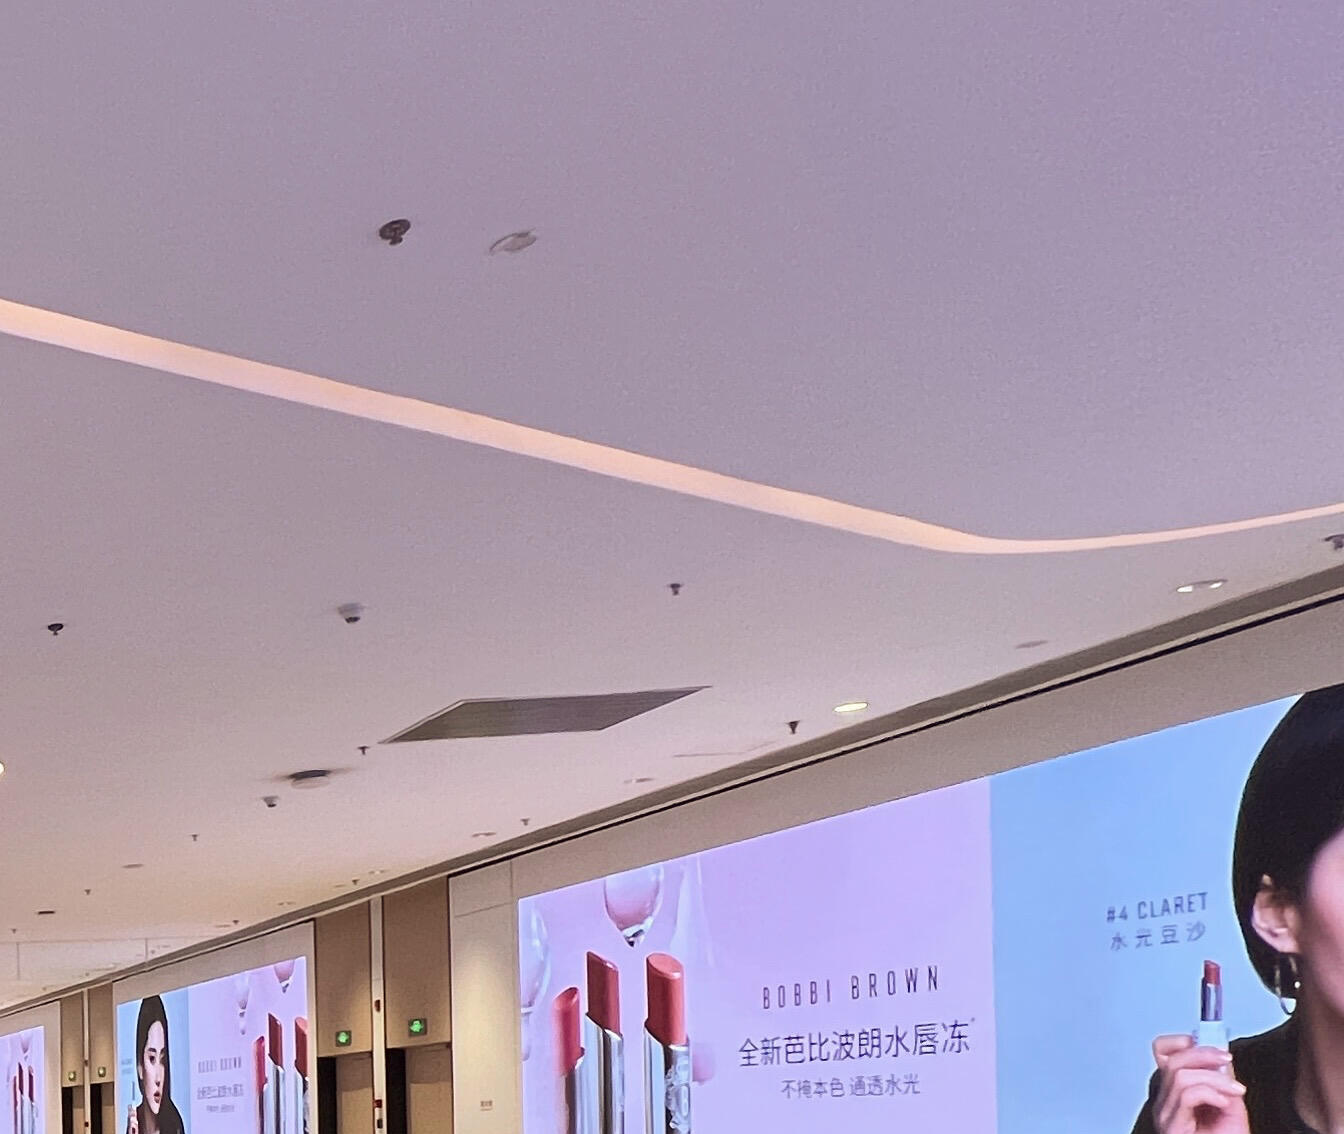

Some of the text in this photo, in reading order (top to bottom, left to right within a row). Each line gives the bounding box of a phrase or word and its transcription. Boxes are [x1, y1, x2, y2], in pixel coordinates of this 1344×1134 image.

[1107, 892, 1208, 922] #4 CLARET
[763, 966, 938, 1009] BOBBI BROWN
[739, 1019, 969, 1067] 全新芭比波朗水唇冻
[850, 1073, 920, 1098] 通透水光
